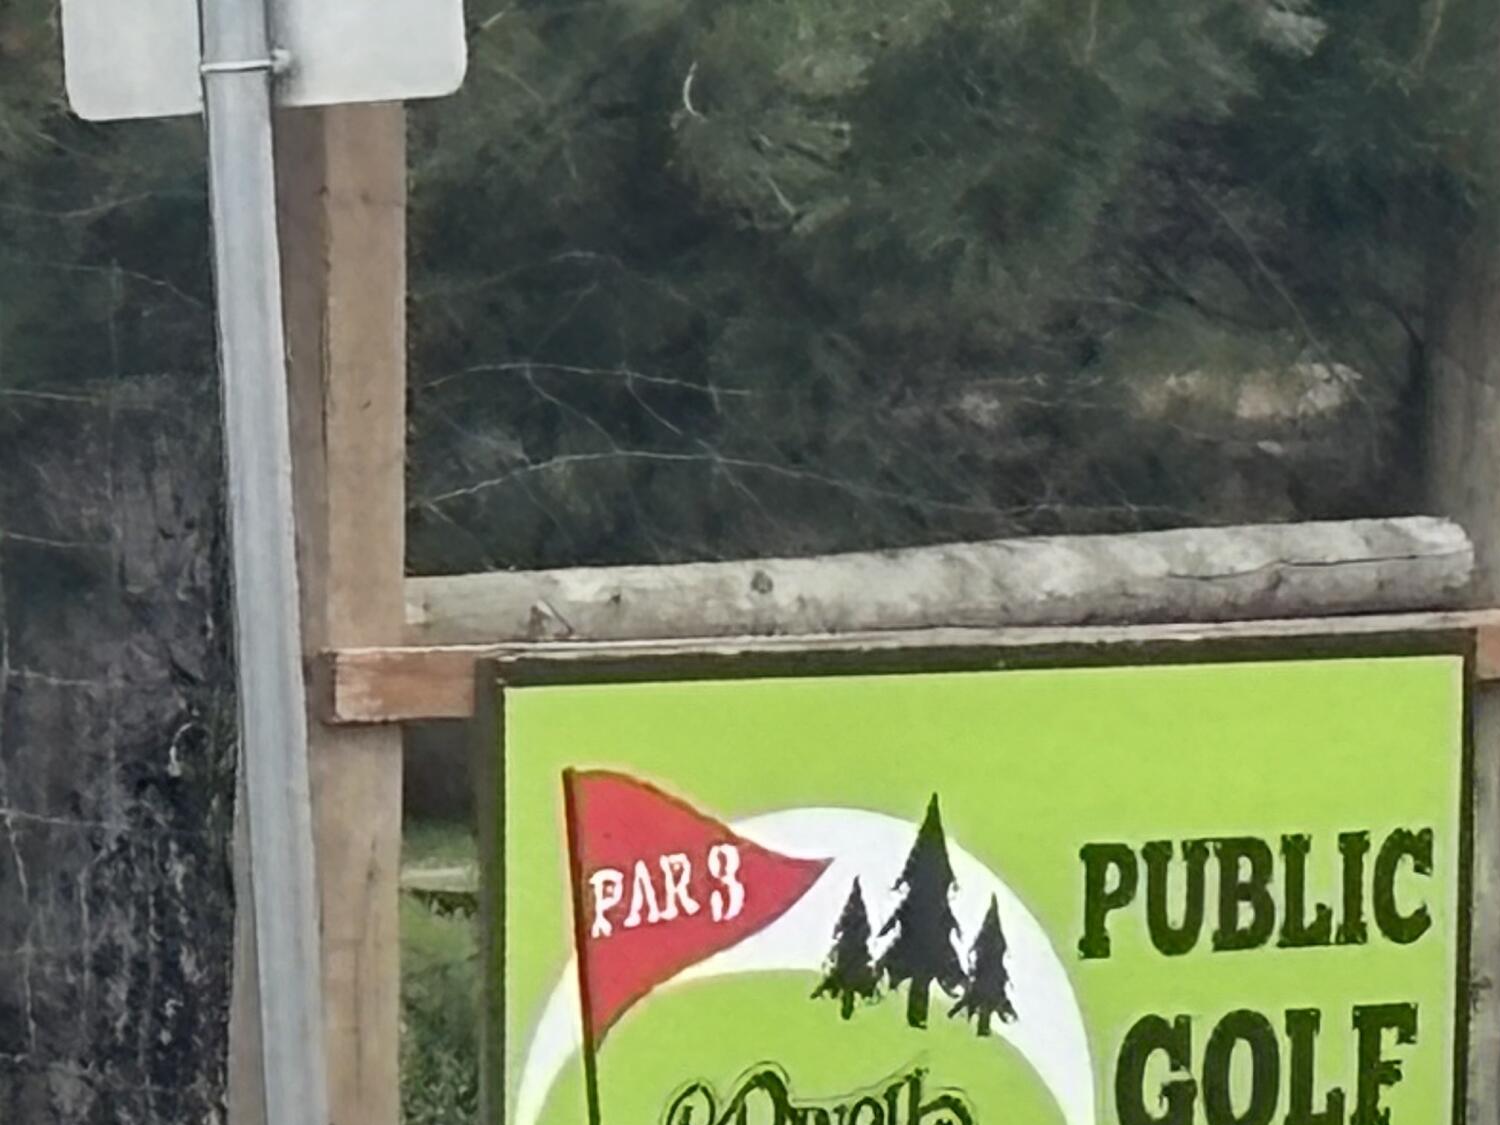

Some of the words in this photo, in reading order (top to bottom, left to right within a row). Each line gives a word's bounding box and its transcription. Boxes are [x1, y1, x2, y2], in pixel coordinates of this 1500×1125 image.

[589, 852, 701, 938] PAR
[707, 843, 746, 923] 3
[1078, 827, 1434, 960] PUBLIC
